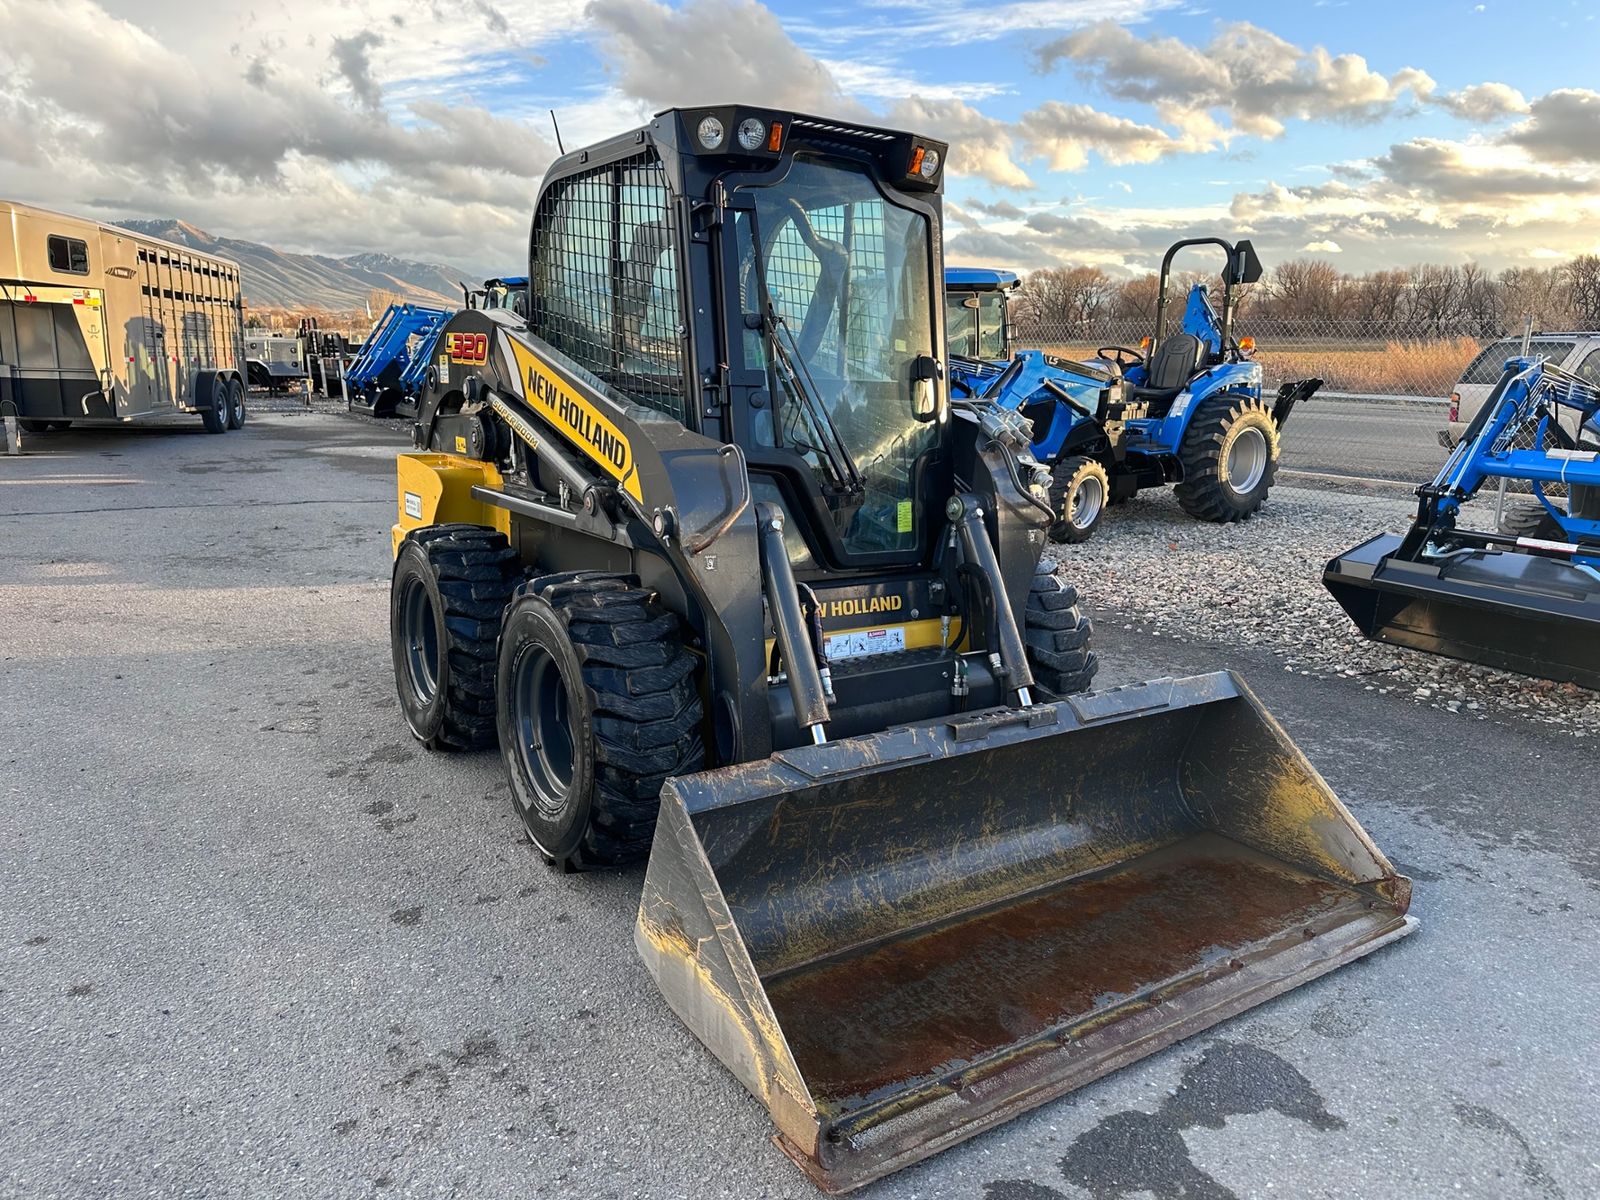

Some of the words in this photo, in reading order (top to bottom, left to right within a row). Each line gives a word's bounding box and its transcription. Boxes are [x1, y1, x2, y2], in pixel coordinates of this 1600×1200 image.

[446, 333, 488, 362] L320
[1048, 356, 1059, 365] LS
[493, 401, 516, 426] SUPER
[528, 366, 557, 410] NEW
[560, 392, 626, 470] HOLLAND
[831, 595, 902, 617] HOLLAND
